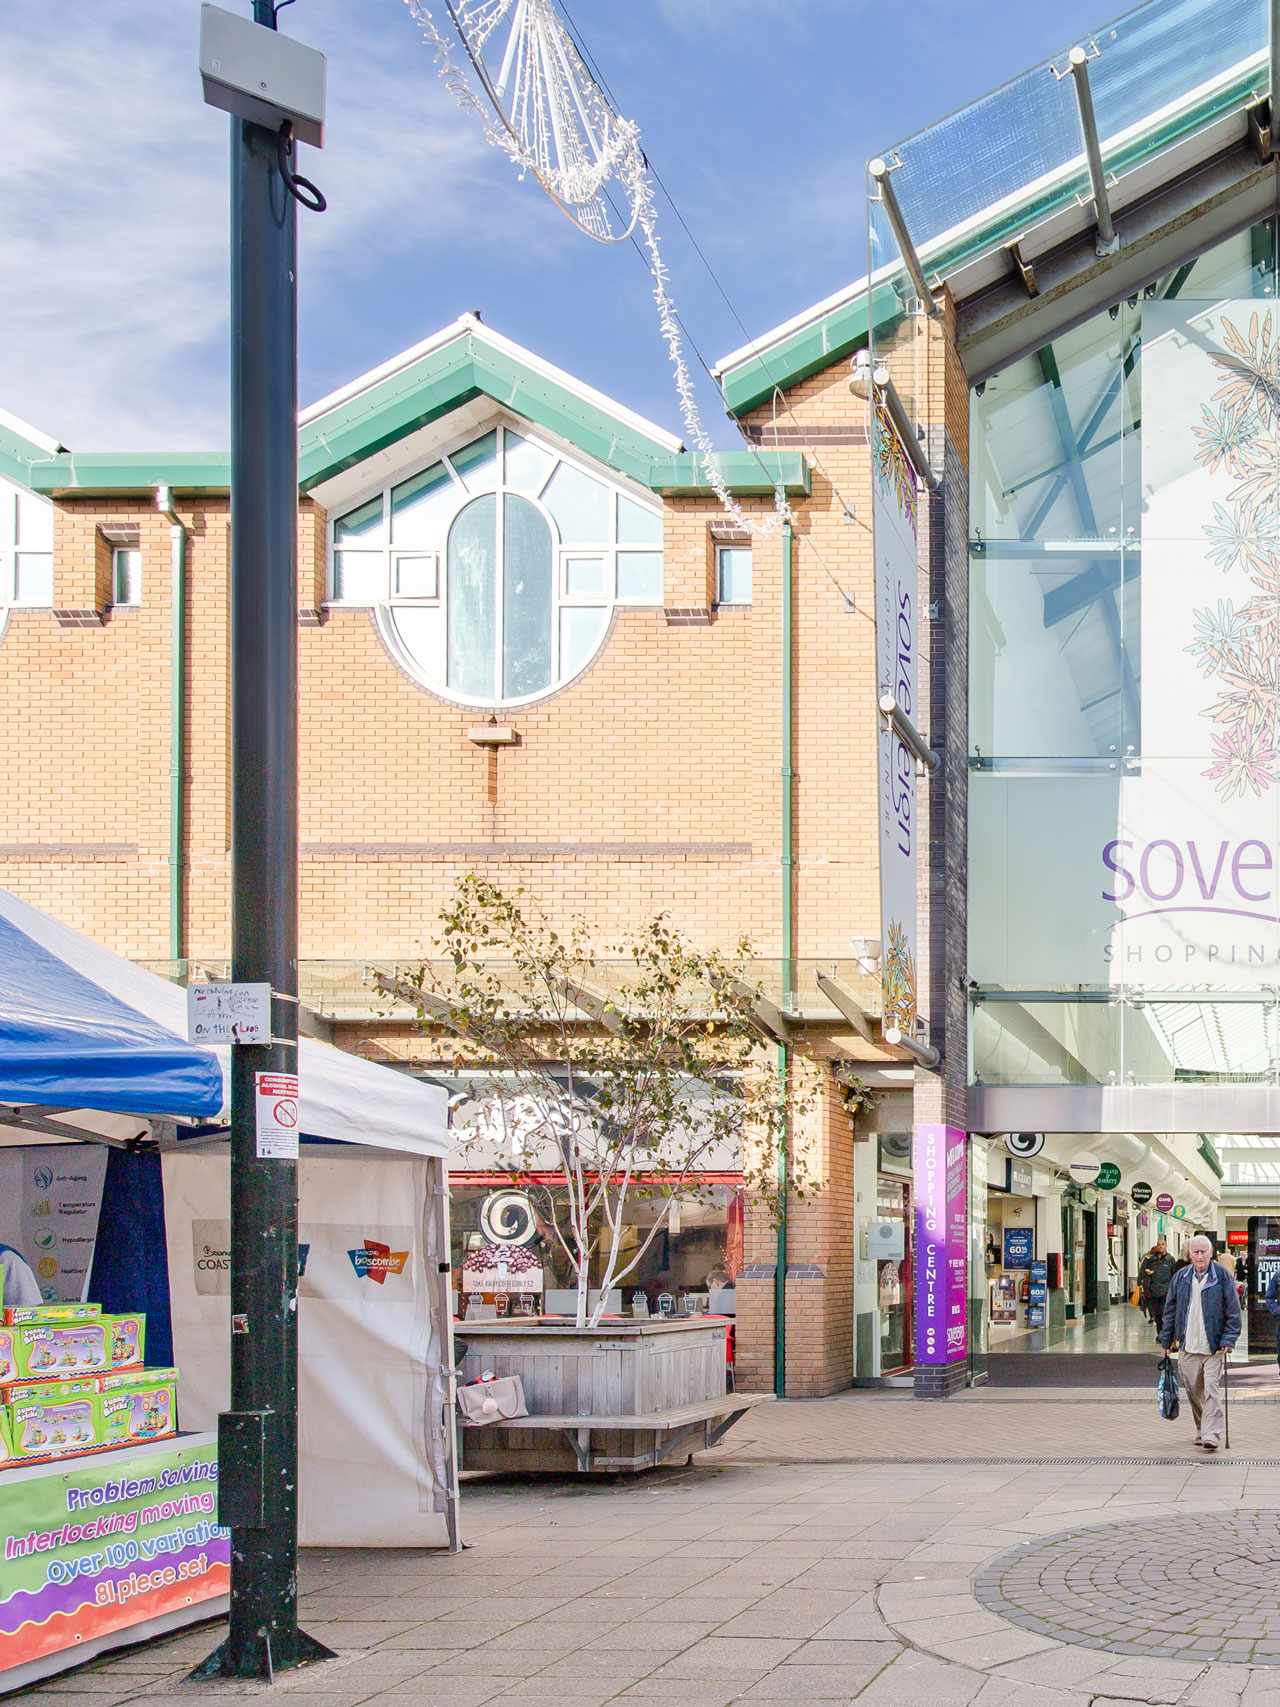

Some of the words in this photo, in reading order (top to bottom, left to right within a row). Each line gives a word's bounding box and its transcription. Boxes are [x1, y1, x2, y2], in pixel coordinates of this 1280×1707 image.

[890, 579, 914, 857] soveeign
[195, 1023, 211, 1034] ON
[925, 1132, 937, 1231] SHOPPING
[354, 1255, 401, 1267] boscombe
[926, 1243, 937, 1317] CENTRE
[23, 1326, 47, 1338] Funny
[23, 1333, 47, 1345] Bricks
[103, 1395, 126, 1408] Funny
[15, 1411, 38, 1424] Bricks
[16, 1404, 37, 1416] Funny
[102, 1402, 128, 1418] Bricks
[67, 1477, 156, 1511] Problem
[158, 1460, 219, 1490] Solving
[5, 1509, 139, 1560] Interlocking
[141, 1491, 215, 1526] moving
[47, 1552, 103, 1583] Over
[105, 1539, 139, 1567] 100
[95, 1578, 116, 1605] 81
[118, 1566, 177, 1605] piece
[178, 1552, 208, 1580] set
